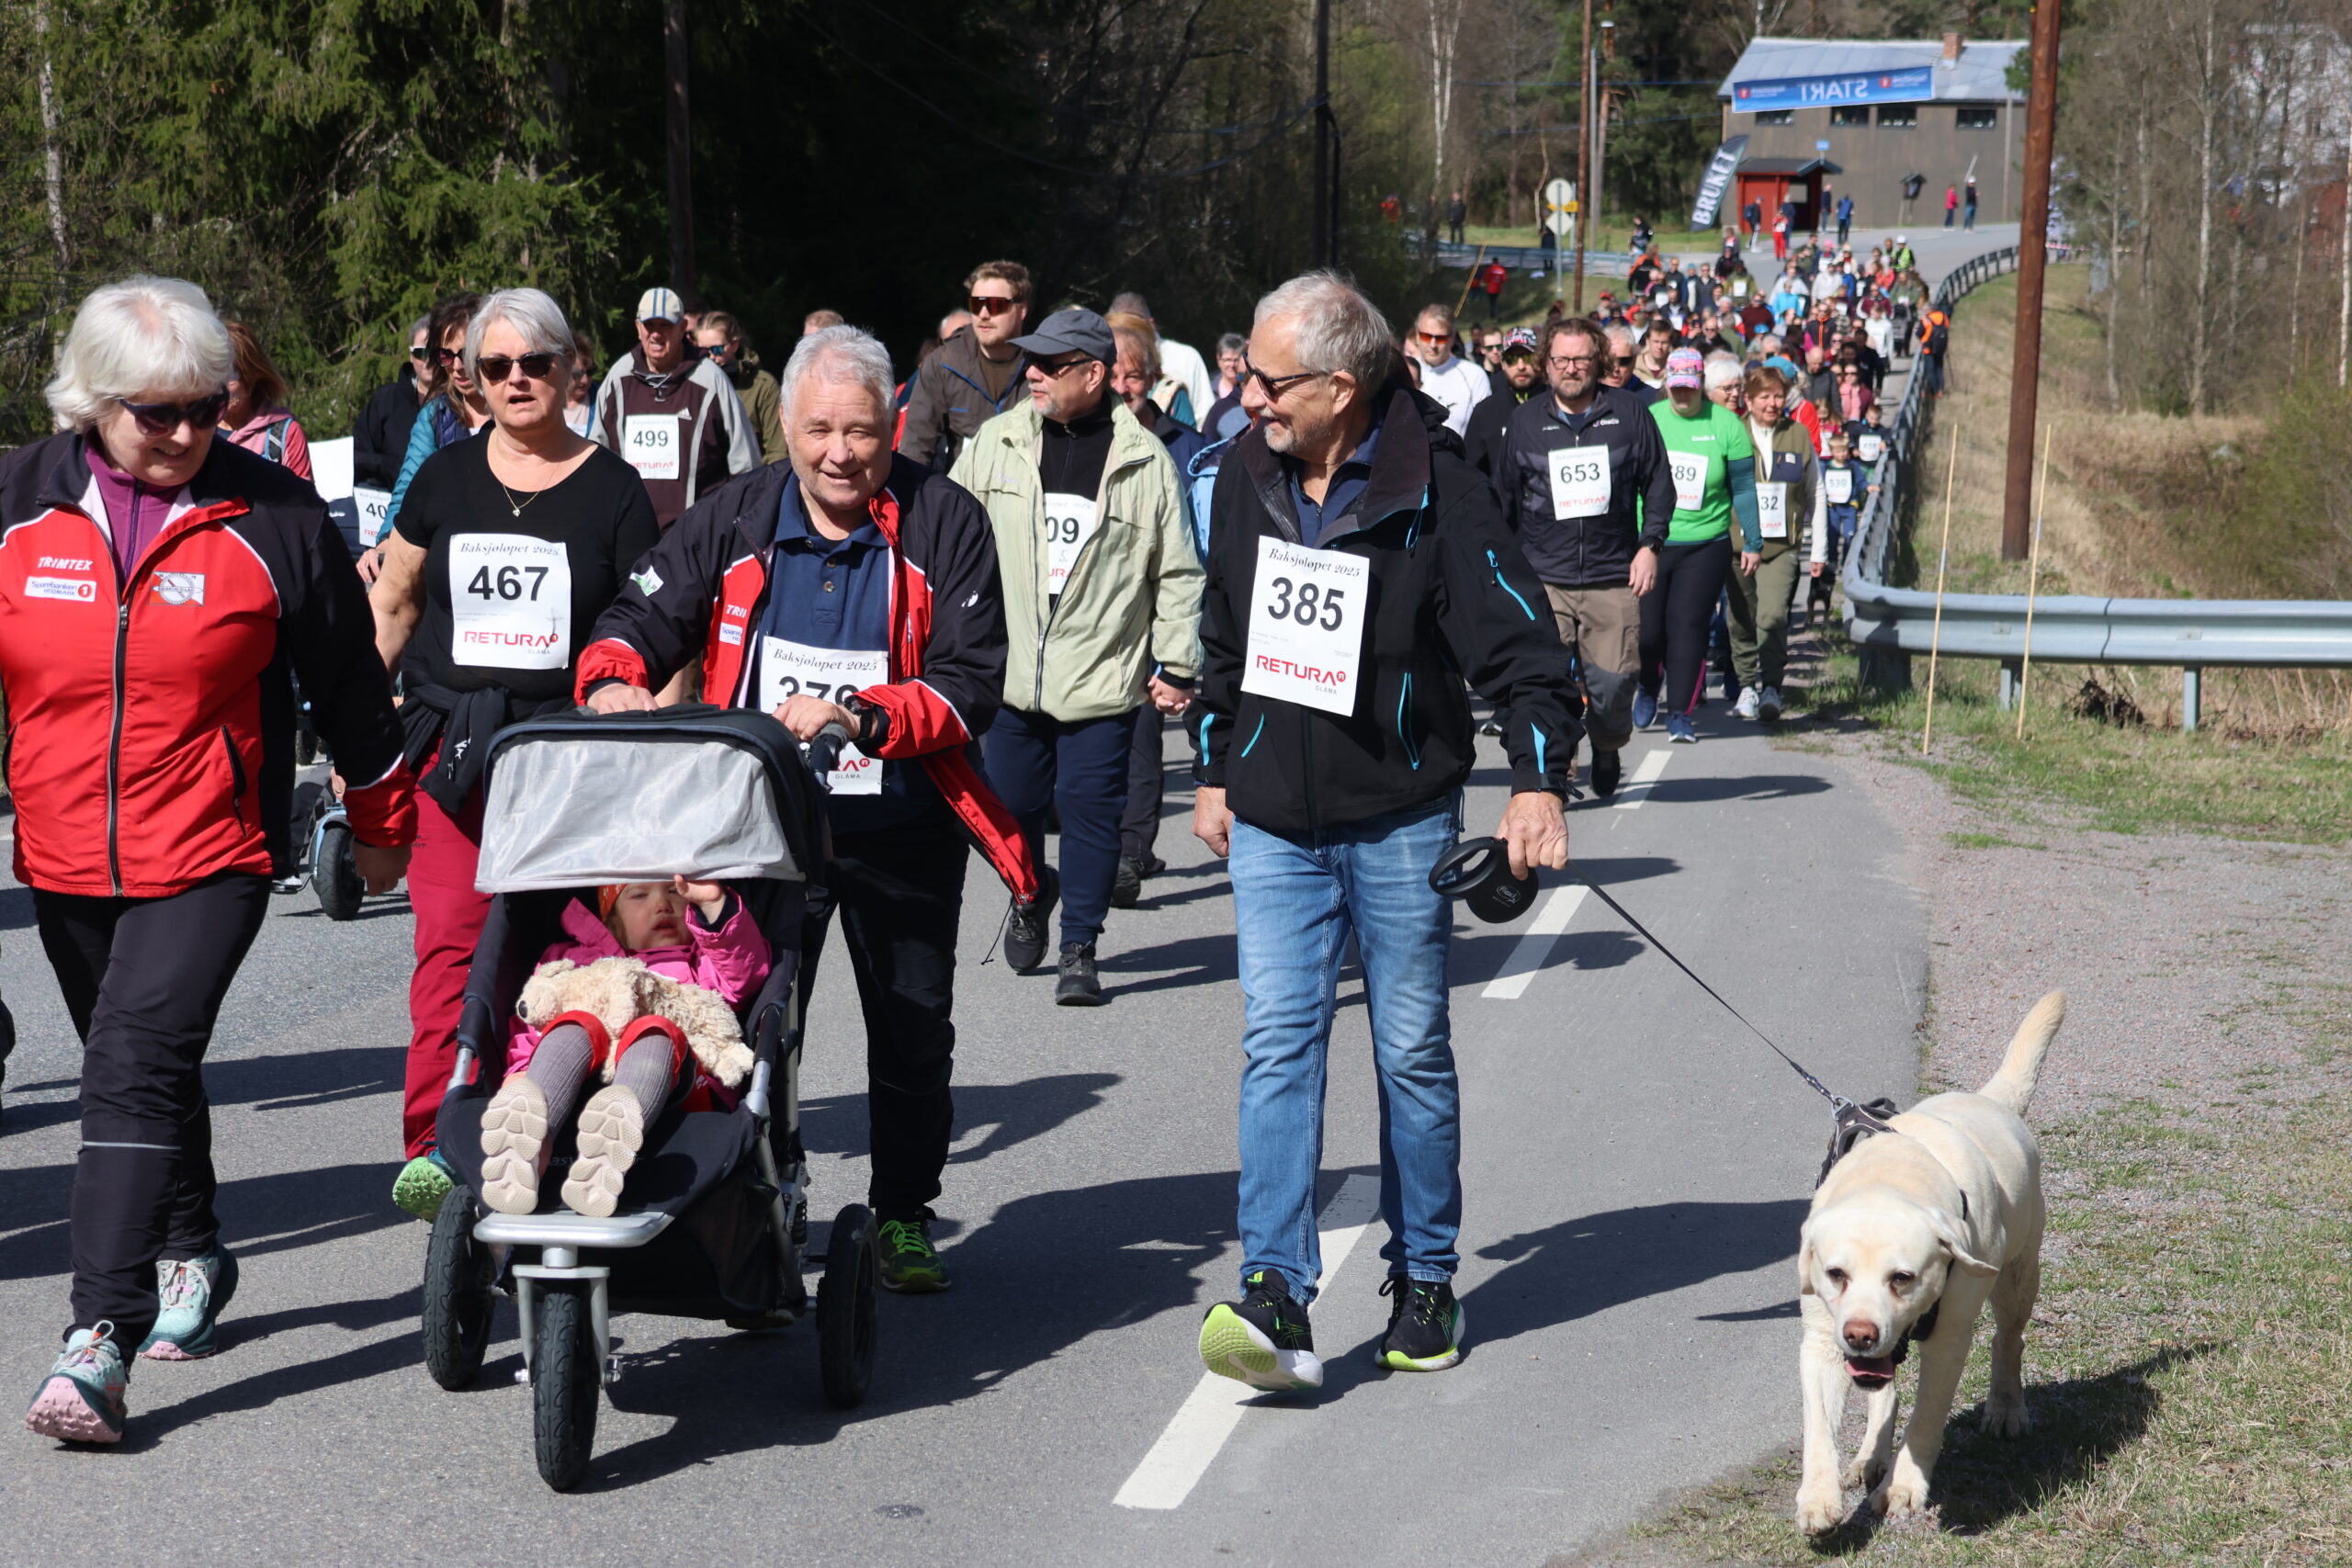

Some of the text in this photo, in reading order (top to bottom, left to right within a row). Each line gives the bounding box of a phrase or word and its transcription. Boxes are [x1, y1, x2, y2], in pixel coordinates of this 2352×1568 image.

[1691, 148, 1736, 225] BRUKET
[633, 430, 669, 447] 499
[1560, 462, 1600, 484] 653
[1672, 465, 1697, 481] 89
[366, 502, 388, 520] 40
[1759, 496, 1779, 511] 32
[1046, 516, 1080, 544] 09
[38, 556, 94, 570] TRIMTEX
[1333, 565, 1362, 578] 2025
[467, 565, 549, 602] 467
[1267, 576, 1345, 632] 385
[464, 631, 550, 648] RETURA
[845, 660, 878, 671] 2025
[1256, 654, 1337, 686] RETURA
